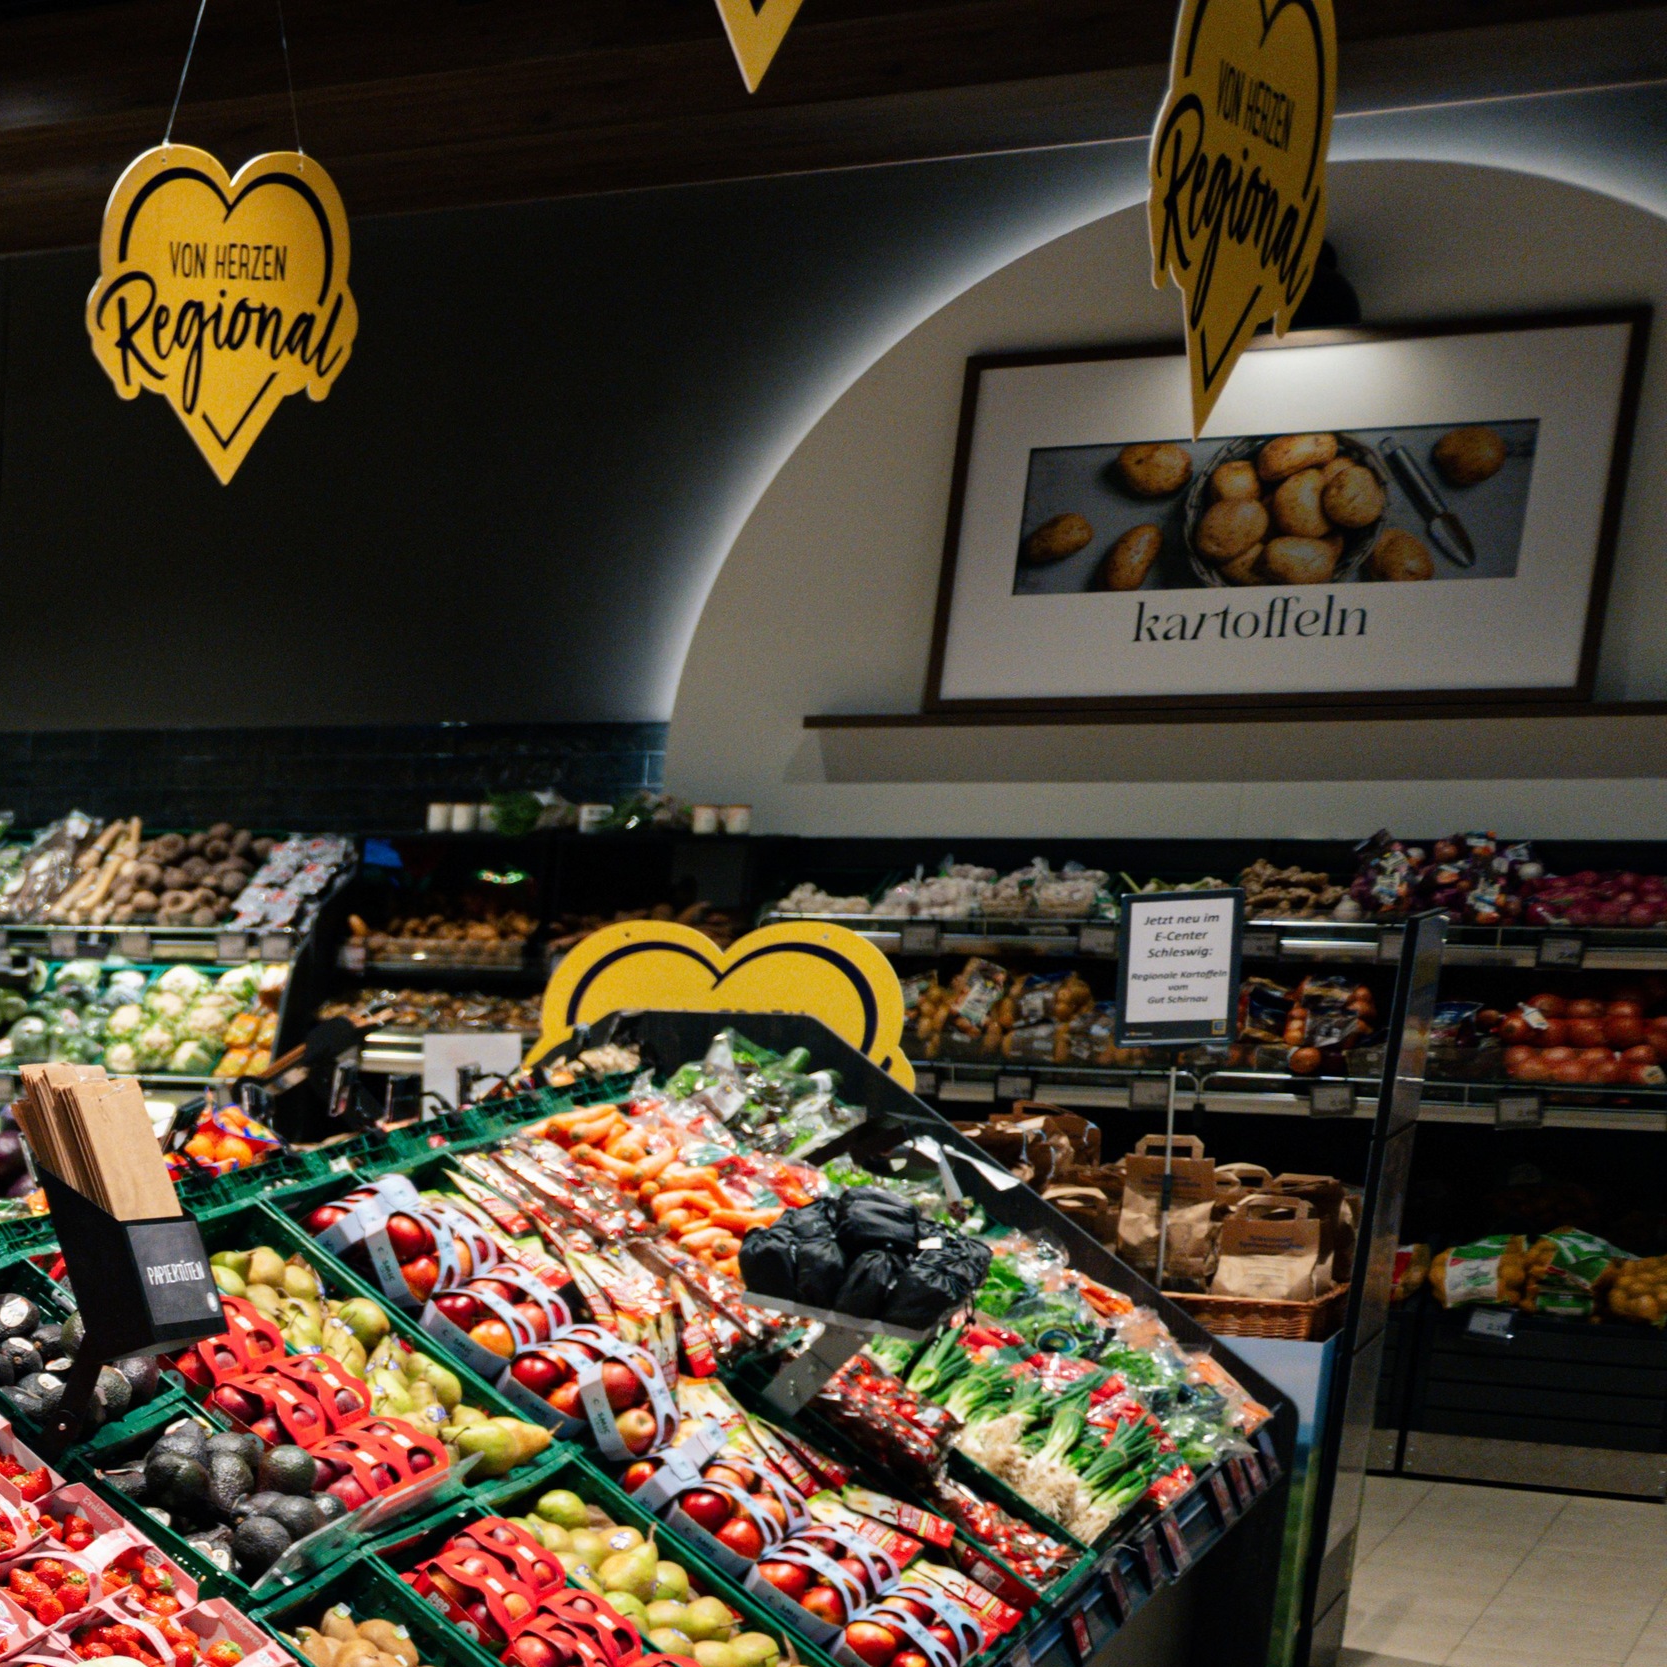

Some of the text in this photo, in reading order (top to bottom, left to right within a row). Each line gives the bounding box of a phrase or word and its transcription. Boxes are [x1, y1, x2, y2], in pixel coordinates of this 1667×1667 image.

[1216, 58, 1296, 153] VON HERZEN
[1157, 93, 1319, 332] Regional
[169, 241, 288, 282] VON HERZEN
[96, 270, 344, 415] Regional
[1132, 595, 1369, 643] kartoffeln
[1144, 915, 1174, 926] Jetzt
[1203, 913, 1220, 922] im
[1154, 931, 1208, 942] E-Center
[1147, 946, 1213, 960] Schleswig:
[1131, 969, 1228, 982] Regionale Kartoffeln
